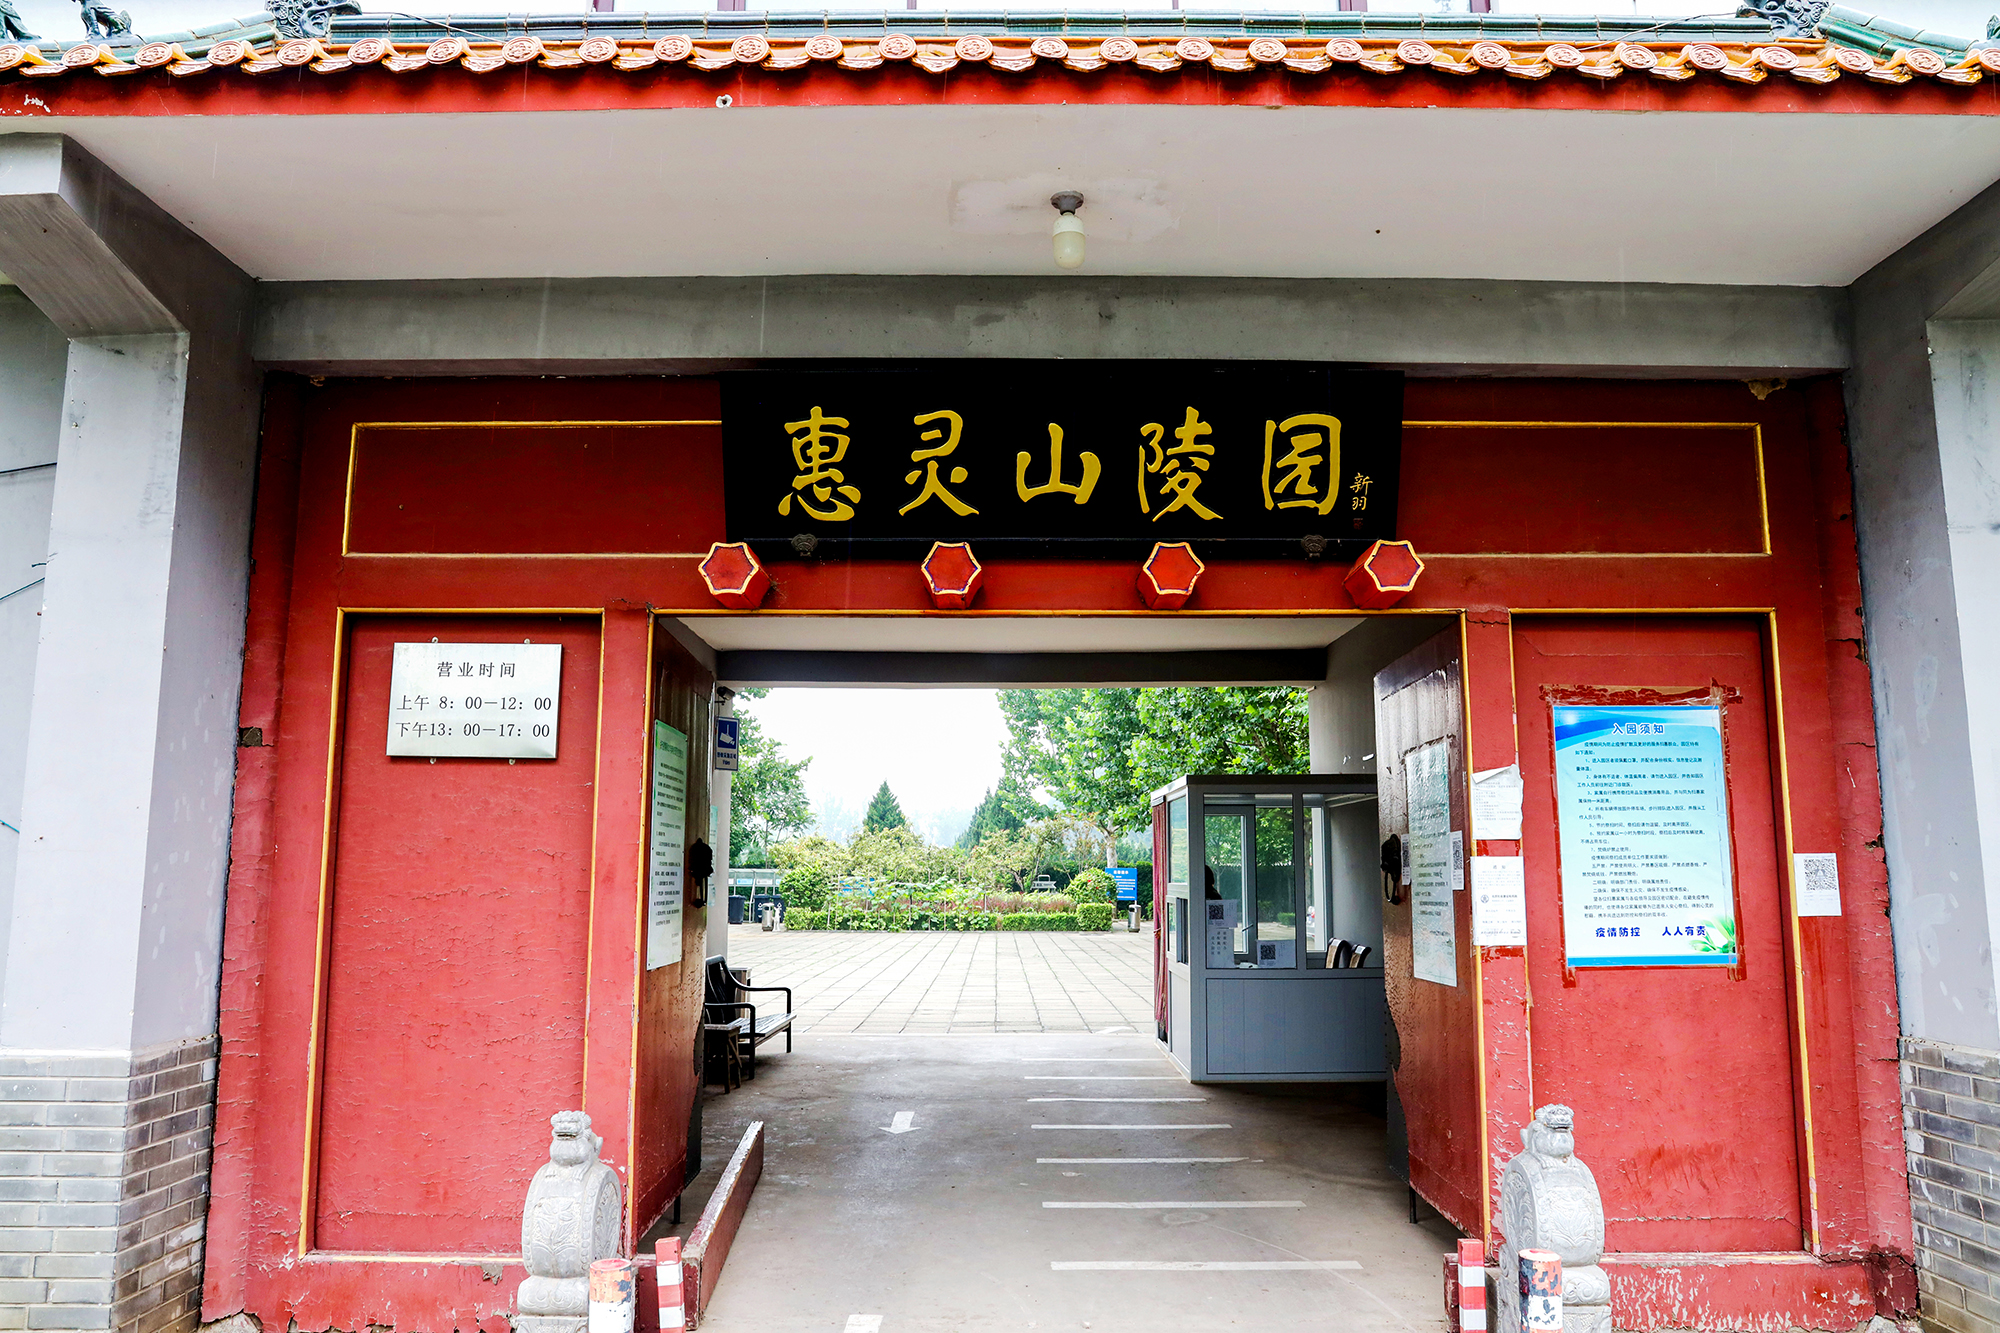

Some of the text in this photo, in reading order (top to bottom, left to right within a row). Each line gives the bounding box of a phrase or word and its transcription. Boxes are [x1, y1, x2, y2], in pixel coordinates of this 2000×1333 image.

[778, 405, 1342, 522] 惠灵山陵园
[437, 661, 516, 678] 营业时间
[396, 694, 430, 711] 上午
[1612, 724, 1664, 735] 入园须知
[1595, 926, 1706, 938] 疫情防控 人人有责
